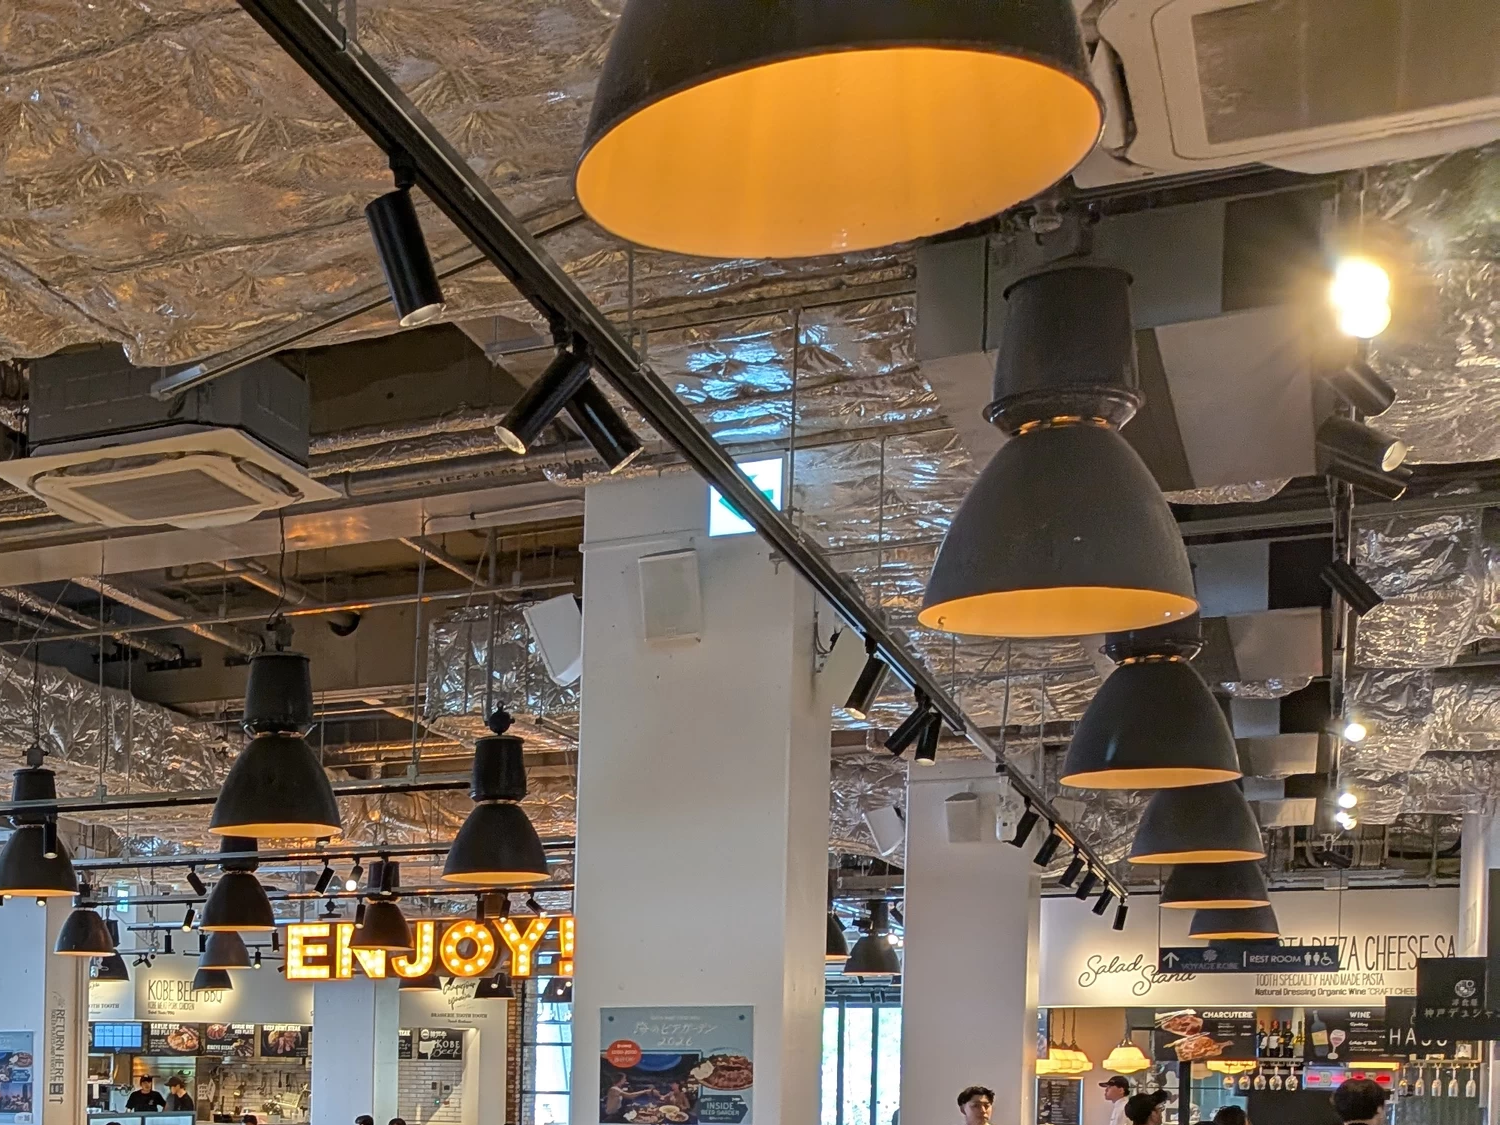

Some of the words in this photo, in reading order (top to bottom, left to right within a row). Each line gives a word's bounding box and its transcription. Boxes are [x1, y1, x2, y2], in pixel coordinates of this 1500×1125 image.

[287, 918, 575, 980] ENJOY!
[1249, 955, 1269, 963] REST
[1271, 955, 1301, 963] ROOM
[1078, 953, 1143, 987] Salad
[1255, 973, 1278, 986] TOOTH
[1279, 973, 1318, 986] SPECIALTY
[1362, 972, 1385, 985] PASTA
[148, 979, 175, 1001] KOBE
[1283, 988, 1316, 996] Dressing
[1318, 988, 1347, 996] Organic
[1349, 987, 1367, 995] Wine
[1202, 1011, 1254, 1019] CHARCUTERIE
[1349, 1011, 1371, 1019] WINE
[55, 1009, 65, 1051] RETURN
[436, 1040, 460, 1048] KOBE
[55, 1054, 65, 1081] HERE
[706, 1102, 735, 1110] INSIDE
